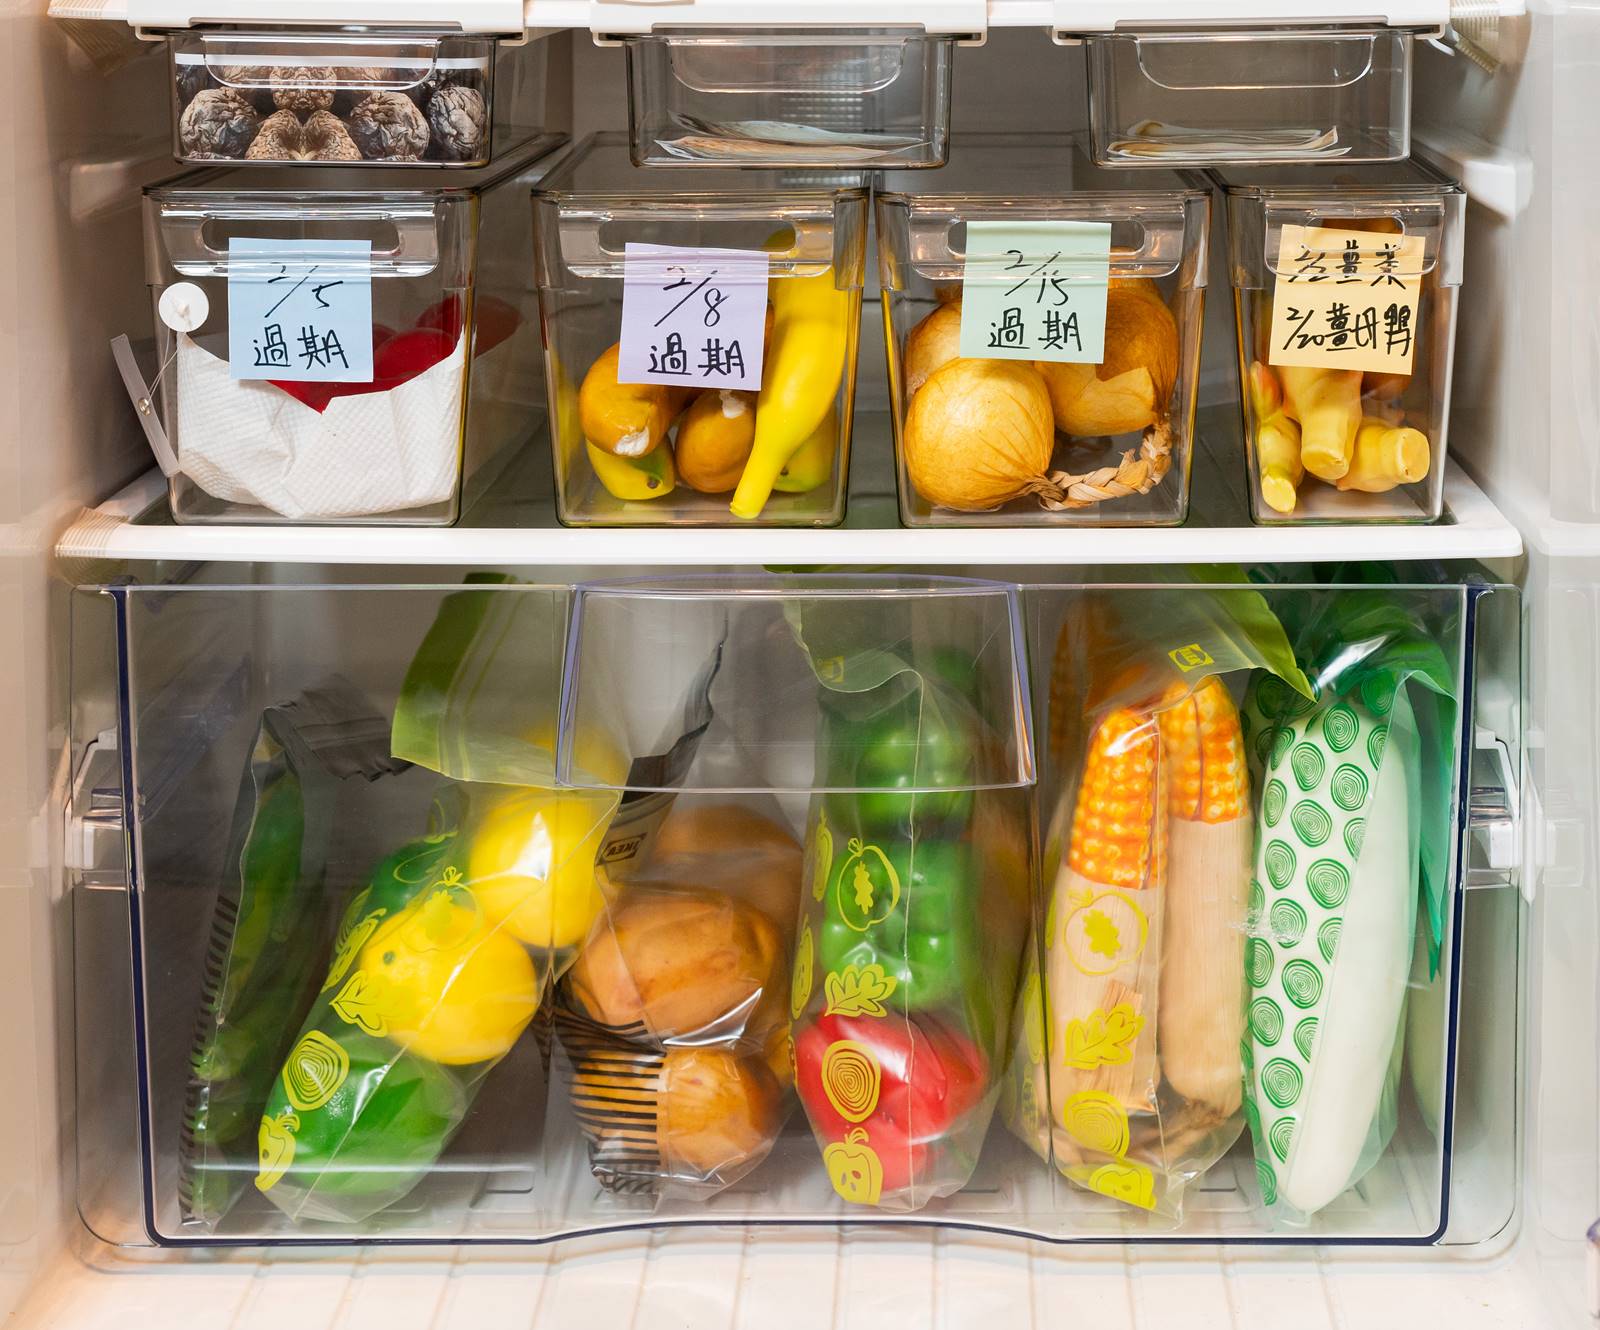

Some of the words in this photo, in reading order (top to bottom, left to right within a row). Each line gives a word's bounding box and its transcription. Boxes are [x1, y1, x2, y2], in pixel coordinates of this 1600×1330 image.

[264, 261, 344, 318] 2/5
[653, 265, 730, 328] 2/8
[1003, 249, 1070, 306] 2/15
[253, 323, 349, 370] 過期
[647, 332, 745, 379] 過期
[987, 307, 1082, 352] 過期
